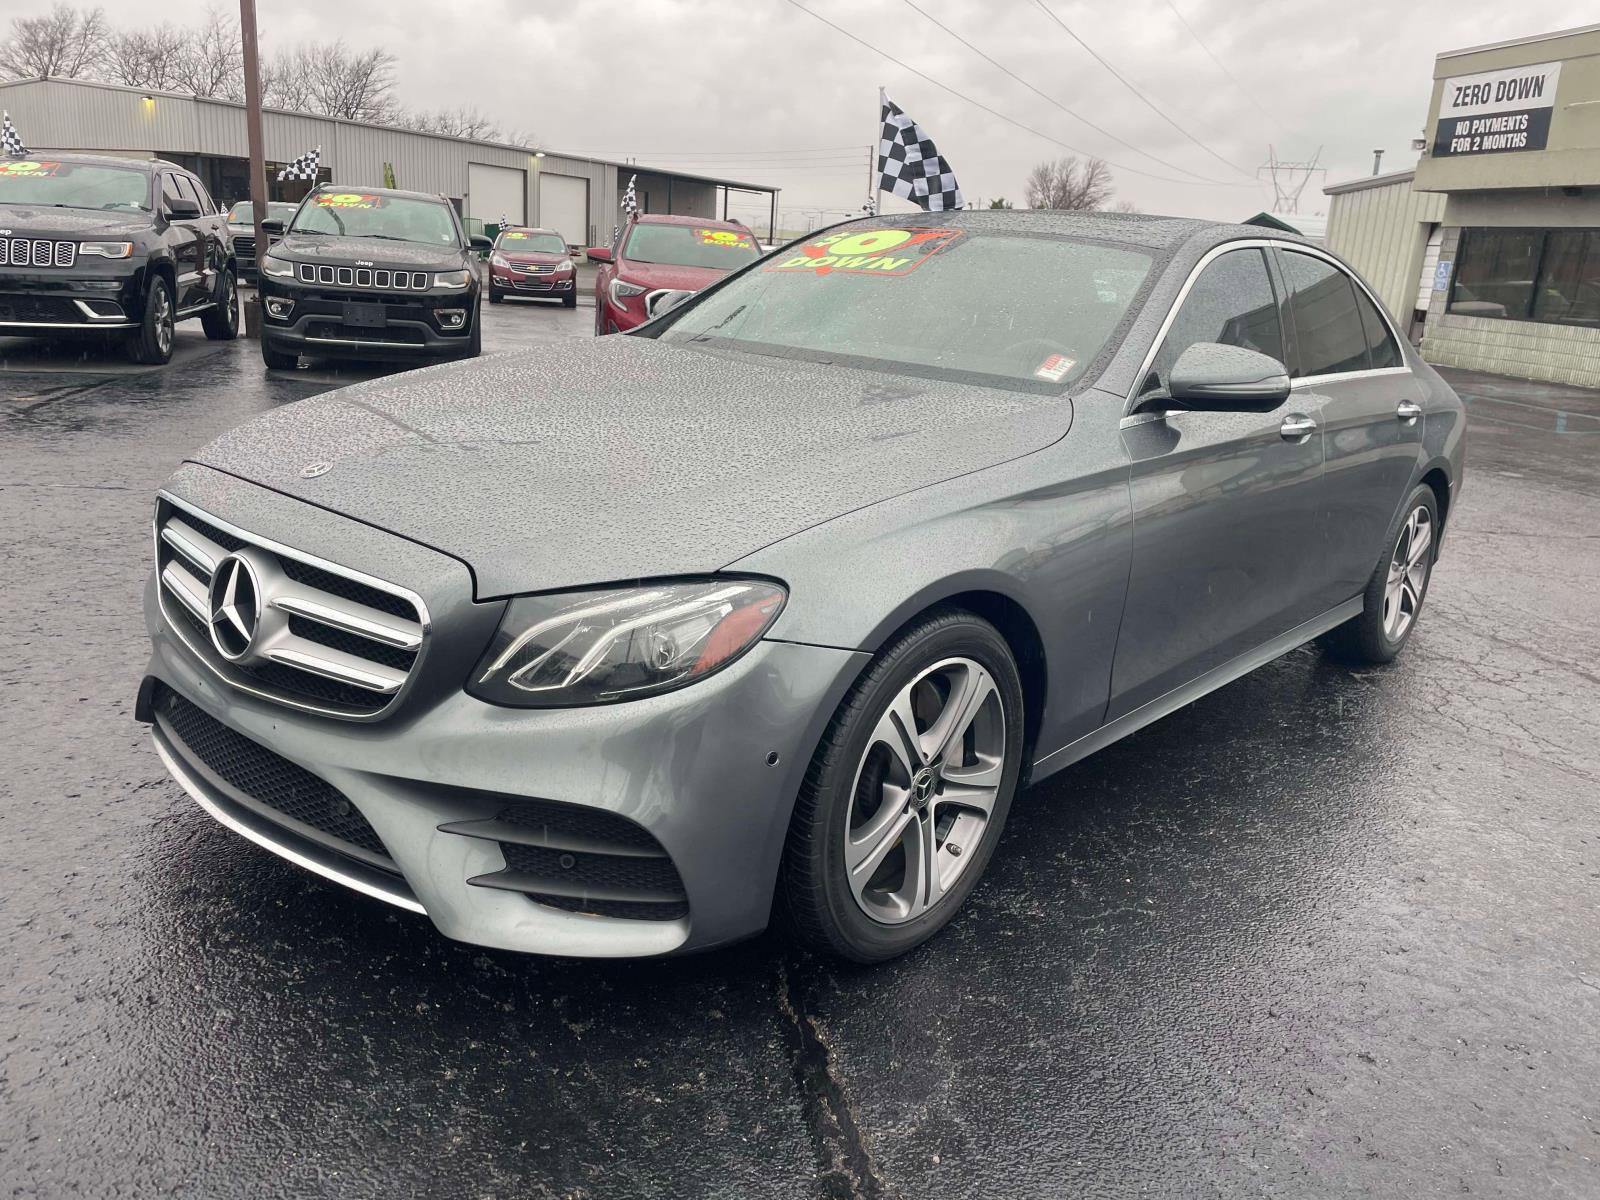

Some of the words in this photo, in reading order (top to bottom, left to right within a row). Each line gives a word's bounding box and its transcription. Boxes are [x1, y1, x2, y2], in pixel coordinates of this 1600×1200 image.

[1452, 82, 1491, 107] ZERO
[1495, 75, 1546, 102] DOWN
[1455, 121, 1470, 136] NO
[1472, 114, 1529, 134] PAYMENTS
[1450, 137, 1471, 153] FOR
[1472, 136, 1481, 151] 2
[1482, 132, 1528, 150] MONTHS
[355, 259, 374, 267] Jeep
[777, 256, 912, 271] DOWN
